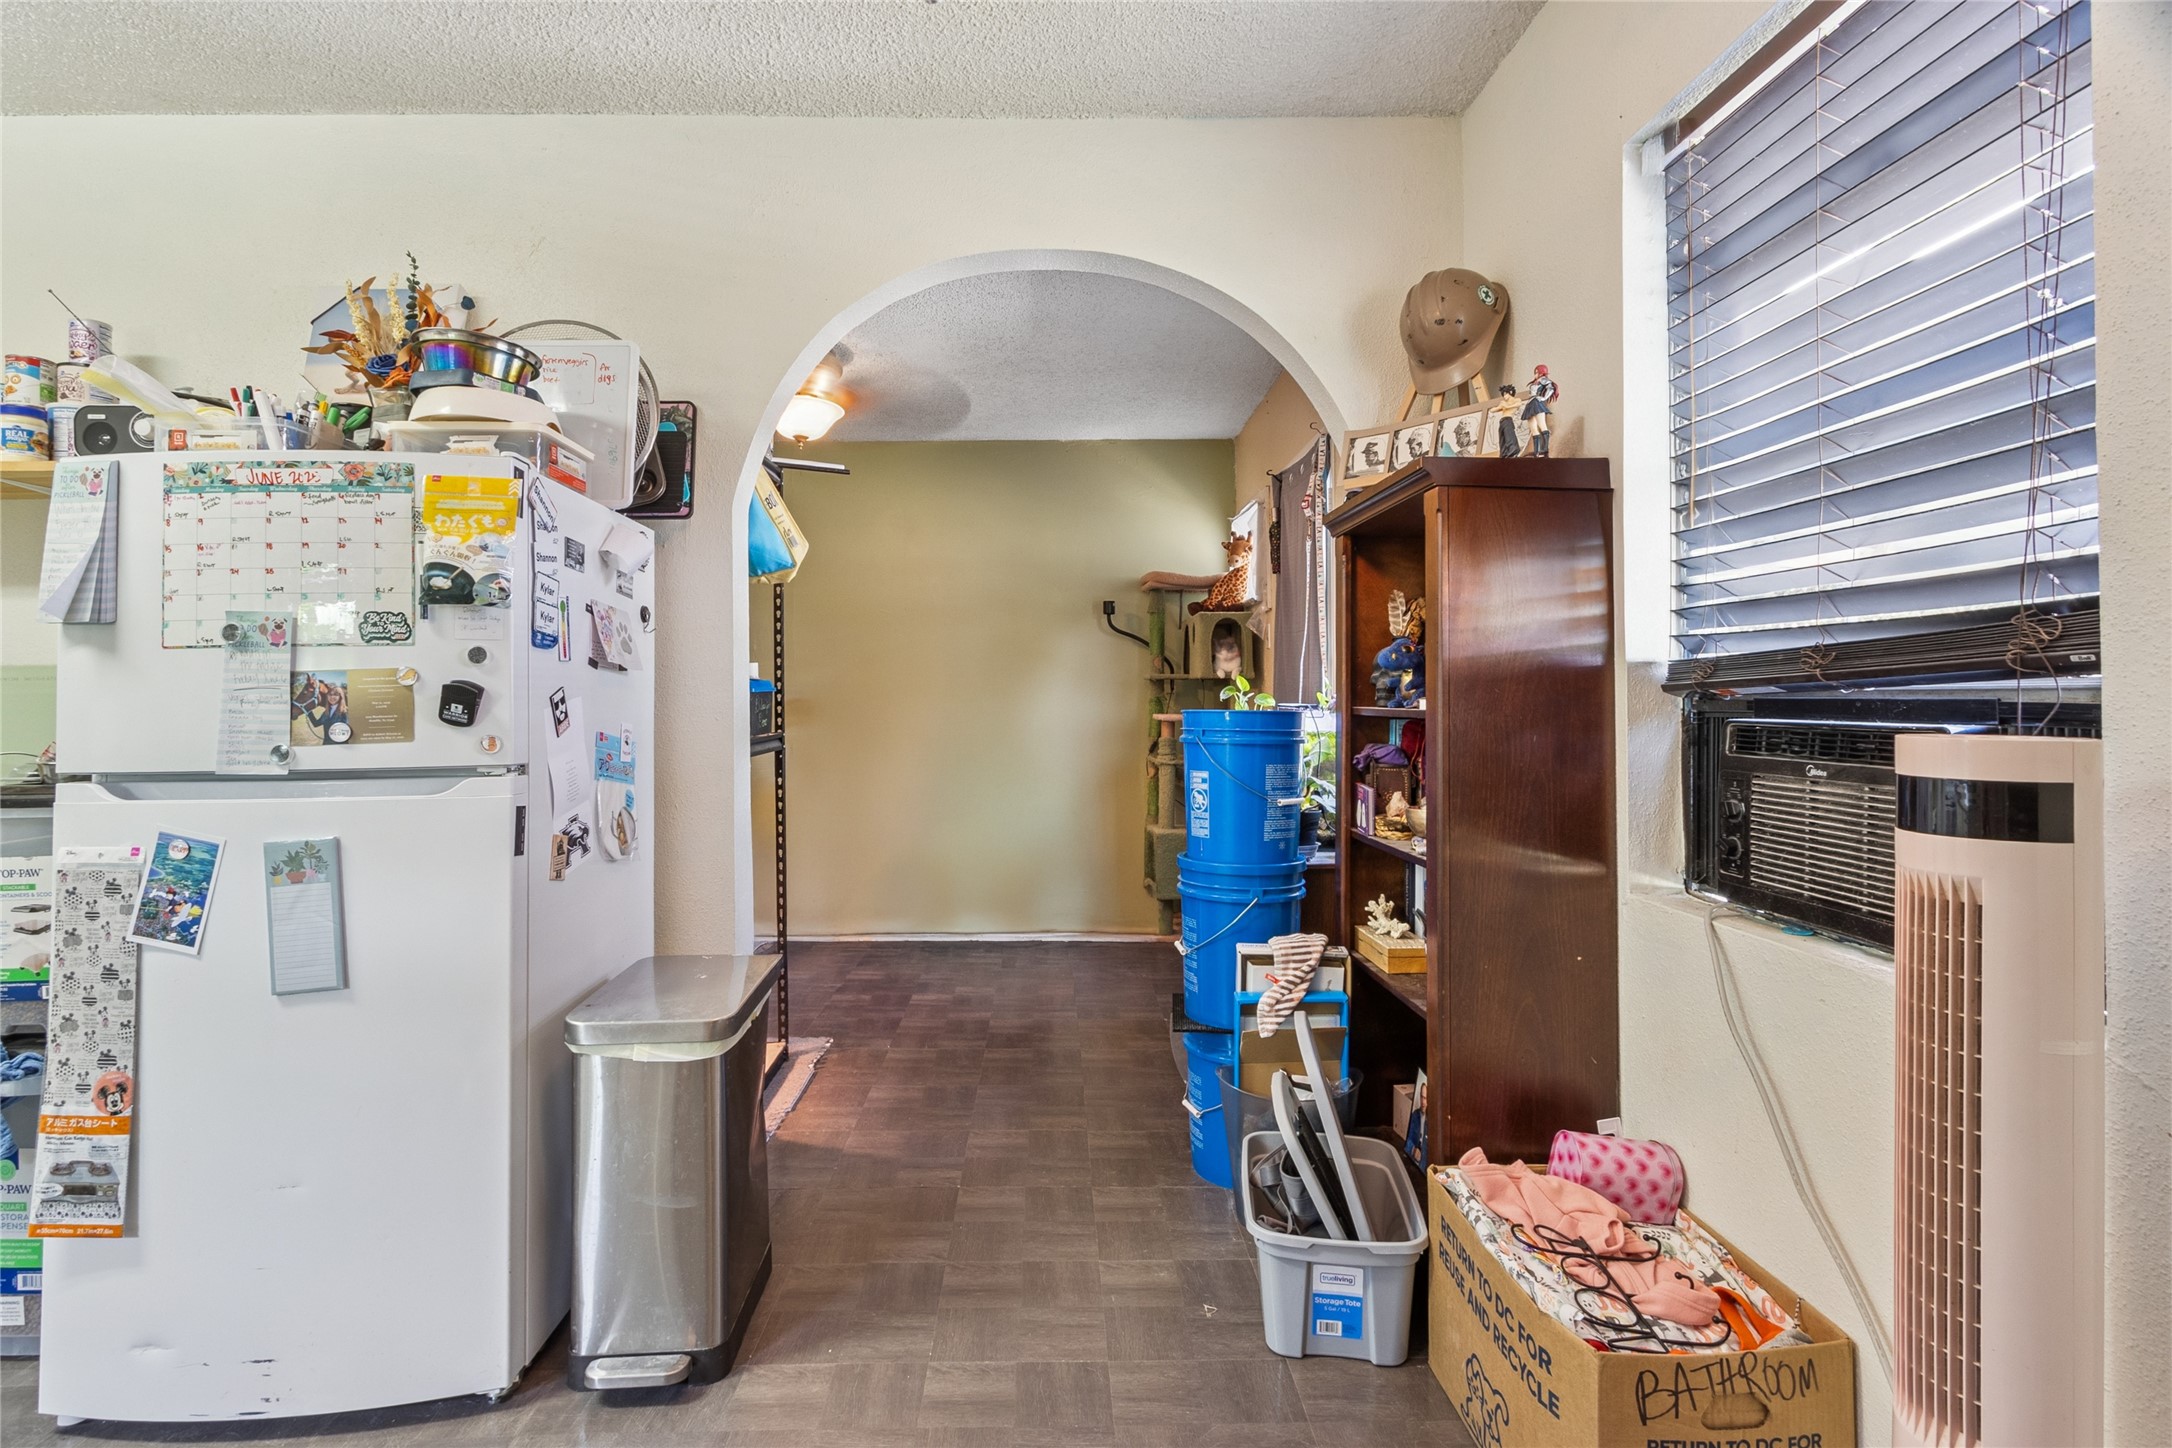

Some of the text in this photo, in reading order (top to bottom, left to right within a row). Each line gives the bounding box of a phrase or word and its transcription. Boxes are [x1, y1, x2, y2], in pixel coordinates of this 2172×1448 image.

[5, 429, 29, 438] REAL
[60, 475, 79, 484] TO DO
[246, 467, 284, 485] JUNE
[533, 484, 556, 525] Shannon
[536, 520, 559, 533] Shaon
[536, 552, 558, 564] Shannon
[540, 581, 556, 597] Kylar
[366, 612, 405, 623] Be Kind
[540, 609, 556, 625] Kylar
[246, 624, 258, 633] DO
[360, 623, 408, 635] Your Mind
[1808, 767, 1828, 777] Midea
[0, 868, 40, 879] OP-PAW
[1322, 1275, 1353, 1284] trueliving
[1440, 1214, 1553, 1377] RETURN TO DC FOR
[1314, 1296, 1361, 1308] Storage Tote
[1438, 1240, 1561, 1421] REUSE AND RECYCLE
[1634, 1351, 1820, 1427] BATHROOM
[1755, 1437, 1782, 1448] DC
[1787, 1433, 1822, 1448] FOR
